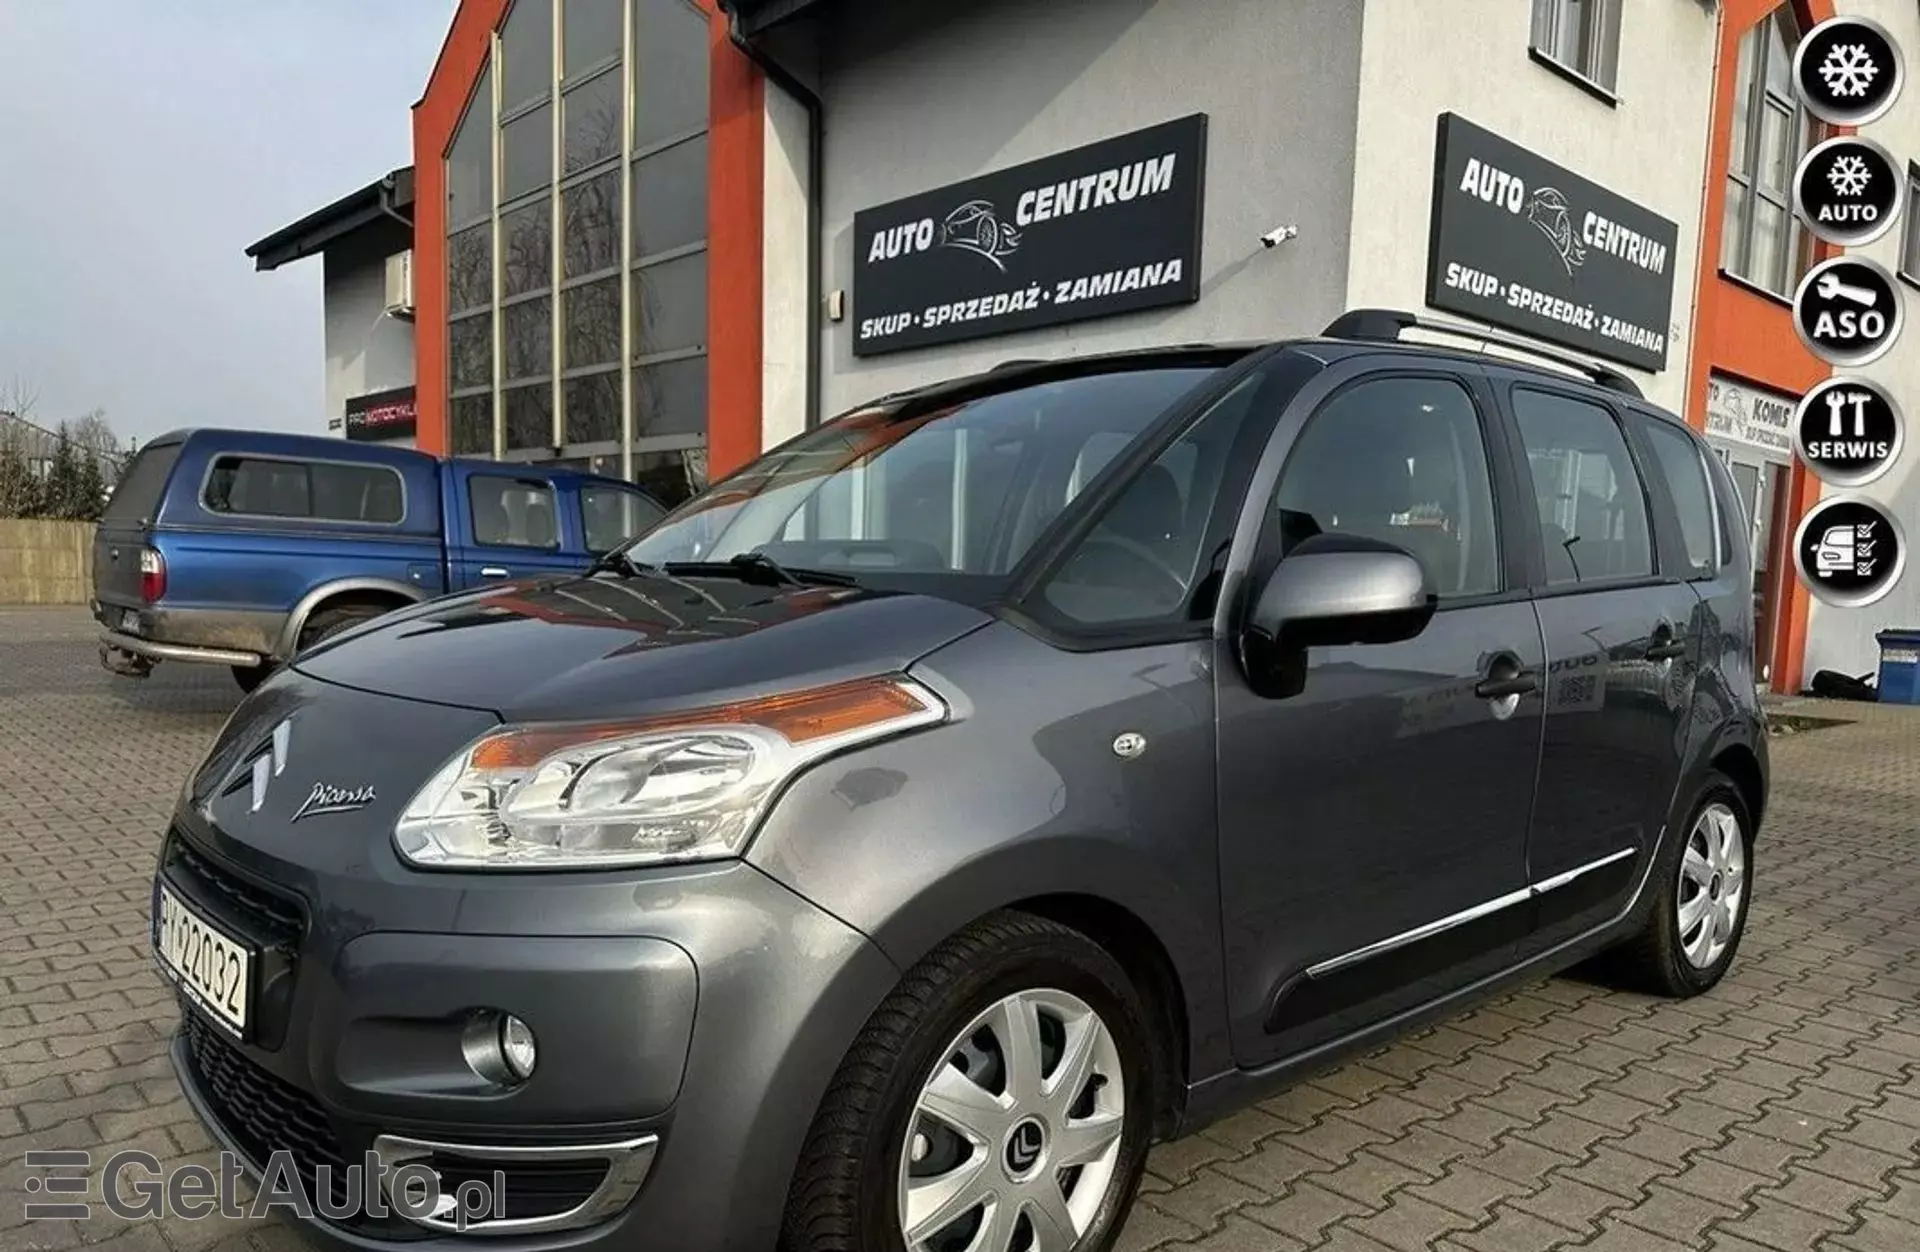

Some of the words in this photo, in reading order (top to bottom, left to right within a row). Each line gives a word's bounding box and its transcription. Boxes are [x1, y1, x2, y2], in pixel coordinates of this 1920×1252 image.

[868, 217, 935, 263] AUTO
[1016, 153, 1176, 226] CENTRUM
[1460, 157, 1525, 214] AUTO
[1583, 210, 1667, 275] CENTRUM
[860, 315, 911, 339] SKUP
[922, 281, 1042, 328] SPRZEDAŻ
[1054, 258, 1182, 304] ZAMIANA
[1445, 262, 1498, 297] SKUP
[1507, 282, 1594, 331] SPRZEDAŻ
[1600, 315, 1664, 355] ZAMIANA
